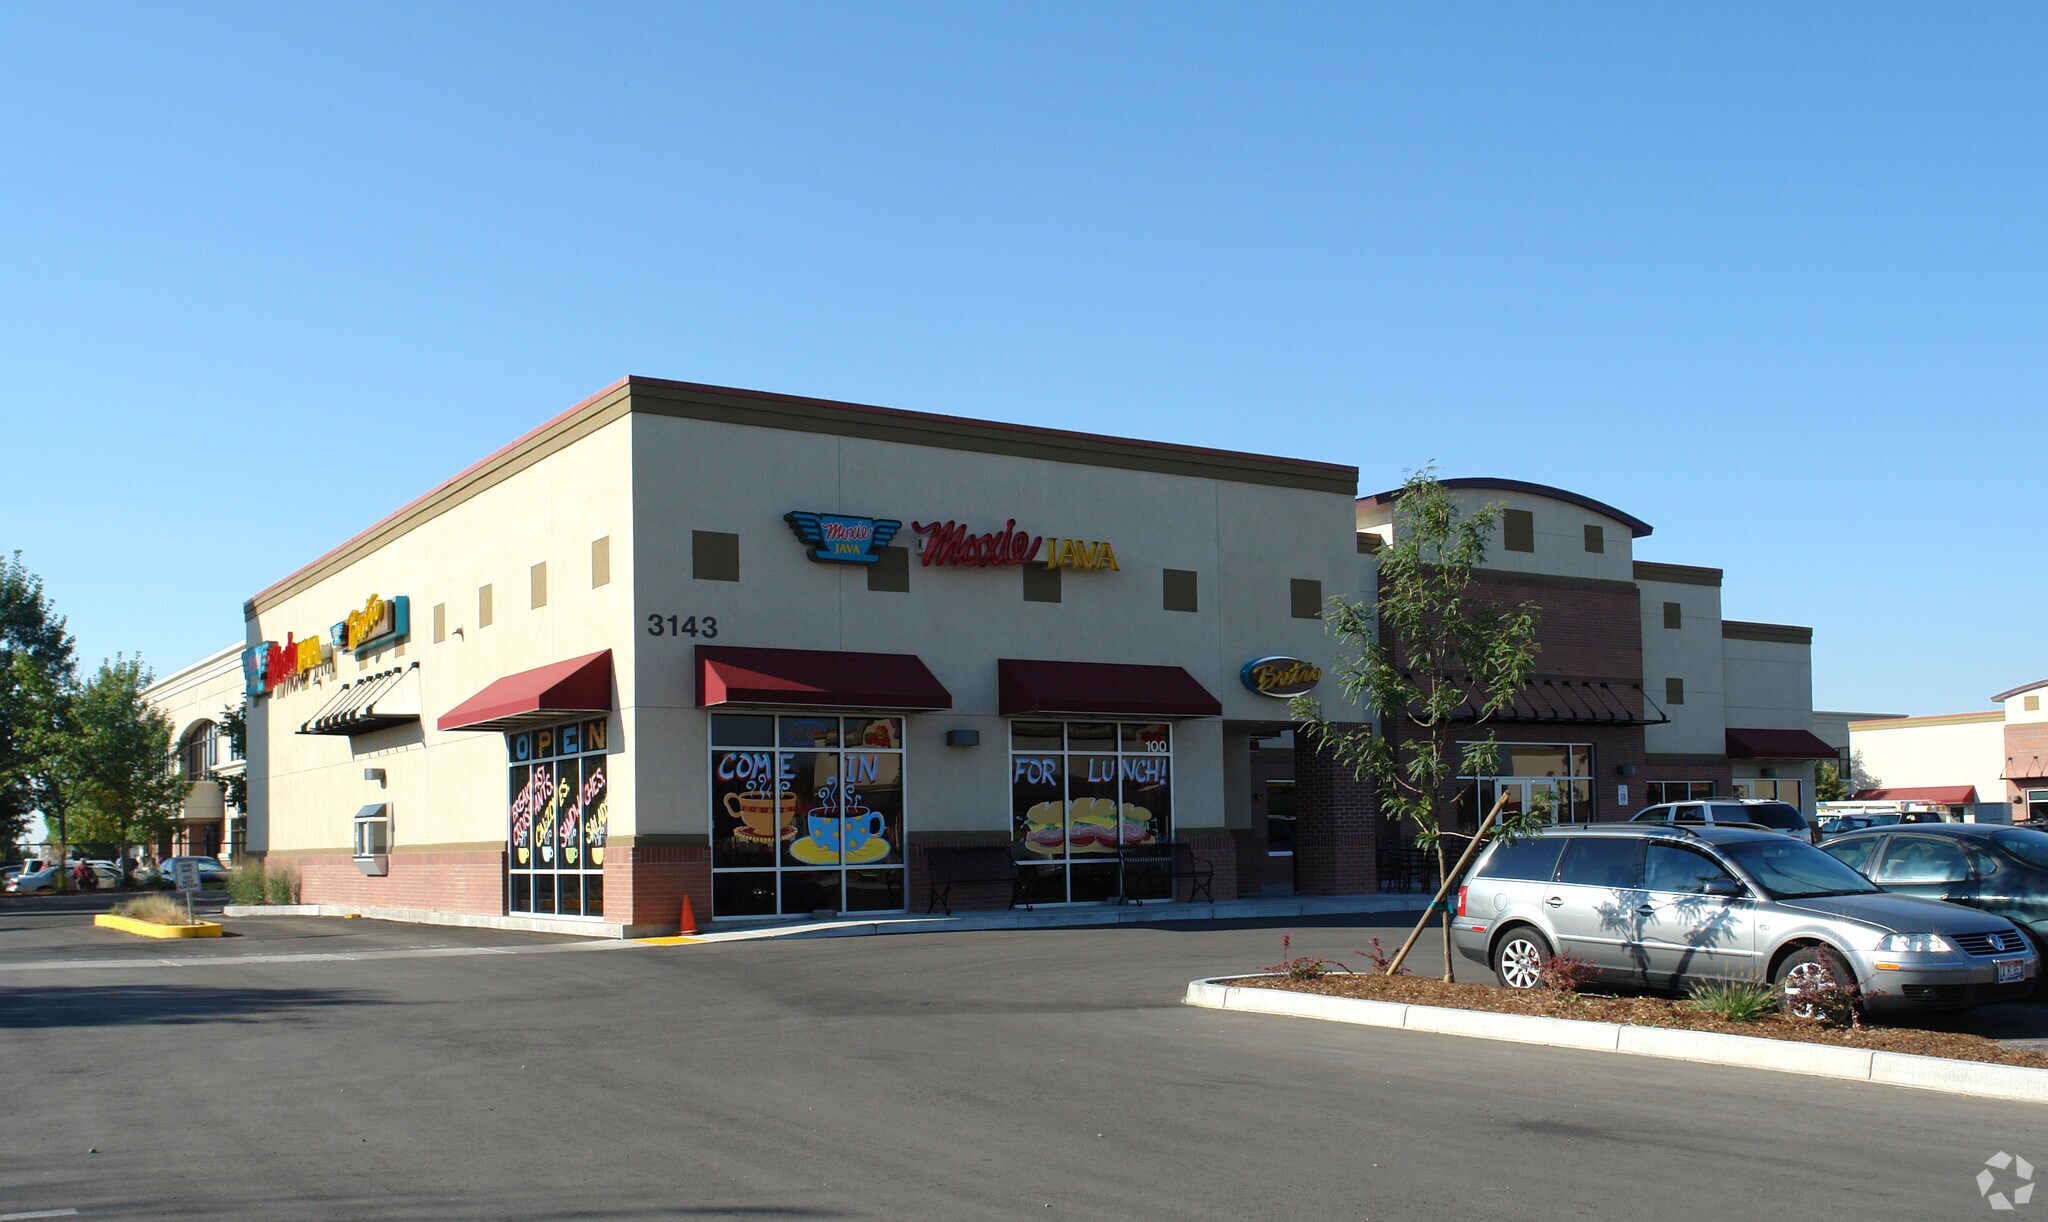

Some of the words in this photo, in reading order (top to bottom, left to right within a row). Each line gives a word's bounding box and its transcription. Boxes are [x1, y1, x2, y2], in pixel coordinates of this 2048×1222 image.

[821, 521, 873, 540] Moxie
[911, 518, 1042, 567] Moxie
[1044, 537, 1120, 571] JAVA
[835, 543, 860, 554] JAVA
[647, 613, 718, 639] 3143
[1252, 661, 1322, 691] Bistro
[516, 720, 605, 761] OPEN
[1145, 740, 1167, 752] 100
[718, 752, 797, 782] COME
[845, 753, 879, 784] IN
[1014, 757, 1057, 786] FOR
[1087, 757, 1167, 786] LUNCH!
